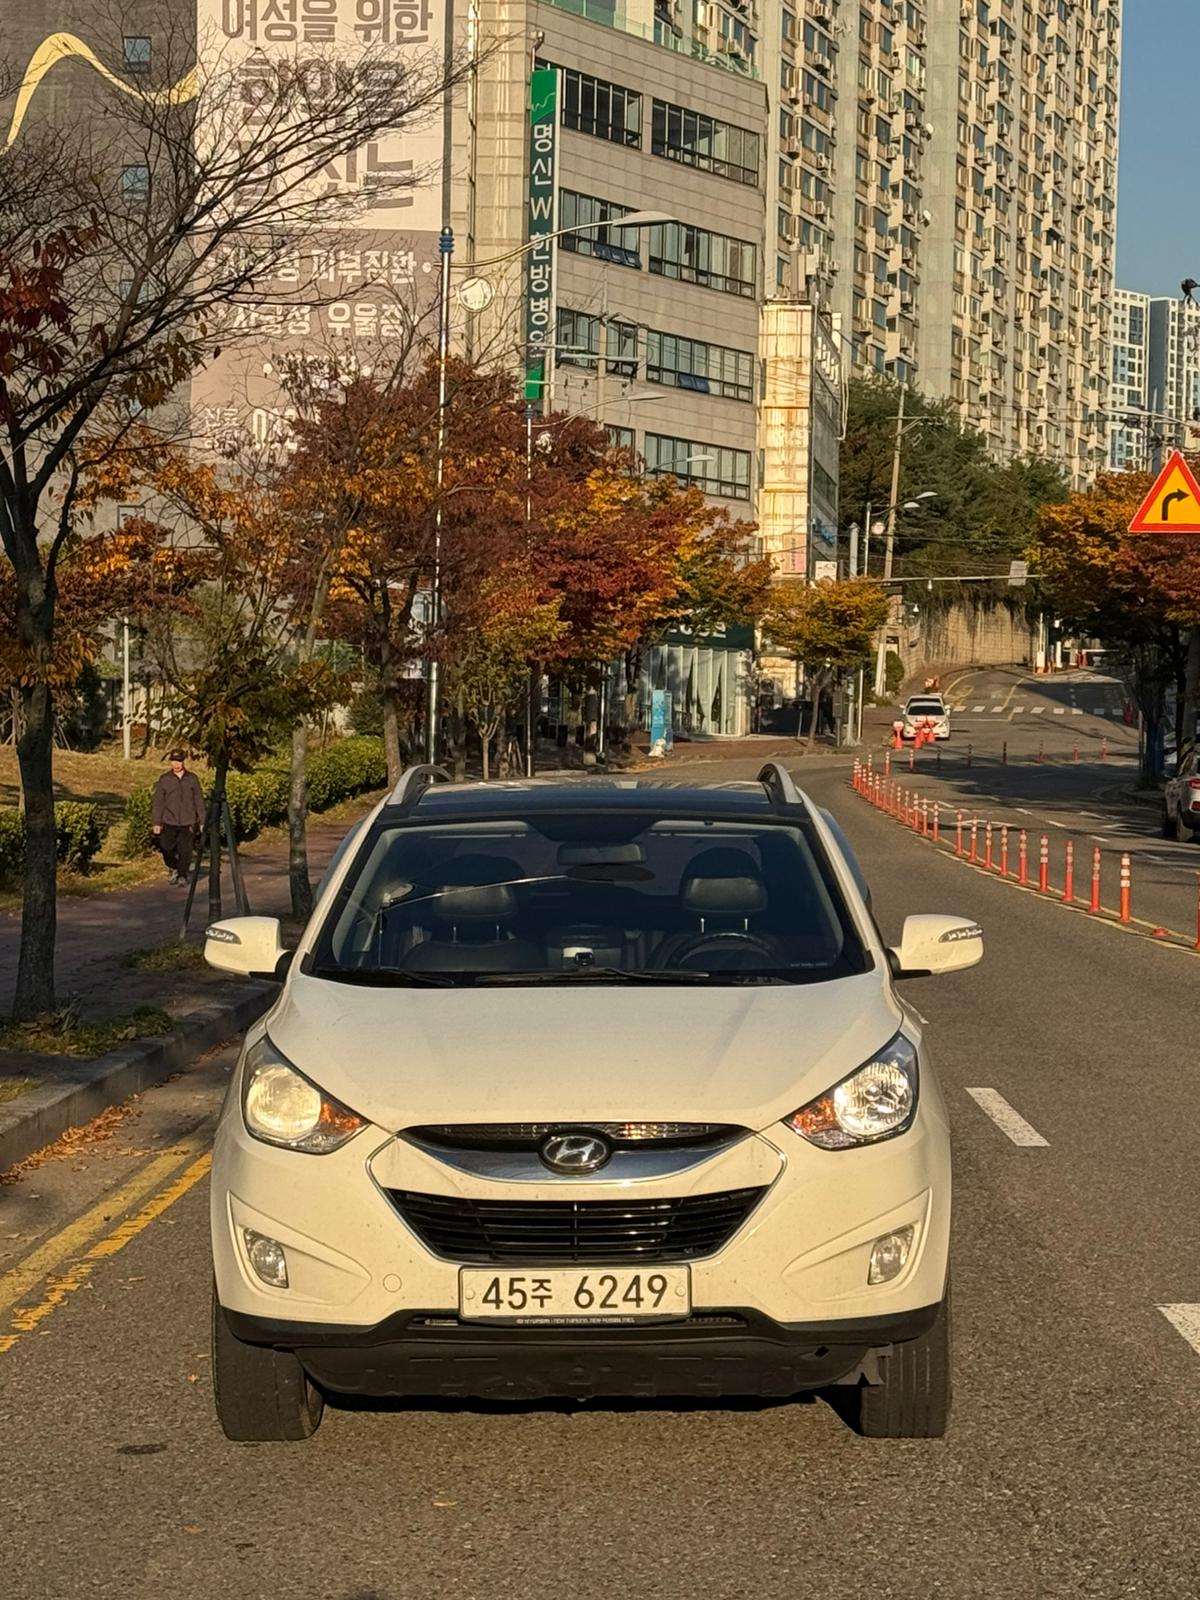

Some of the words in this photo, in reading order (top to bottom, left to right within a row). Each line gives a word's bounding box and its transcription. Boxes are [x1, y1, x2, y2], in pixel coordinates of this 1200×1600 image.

[221, 0, 338, 43] 여성을
[354, 0, 433, 45] 위한
[311, 248, 417, 284] 피부질환
[327, 302, 404, 337] 우울증
[481, 1276, 553, 1310] 45주
[573, 1274, 668, 1310] 6249
